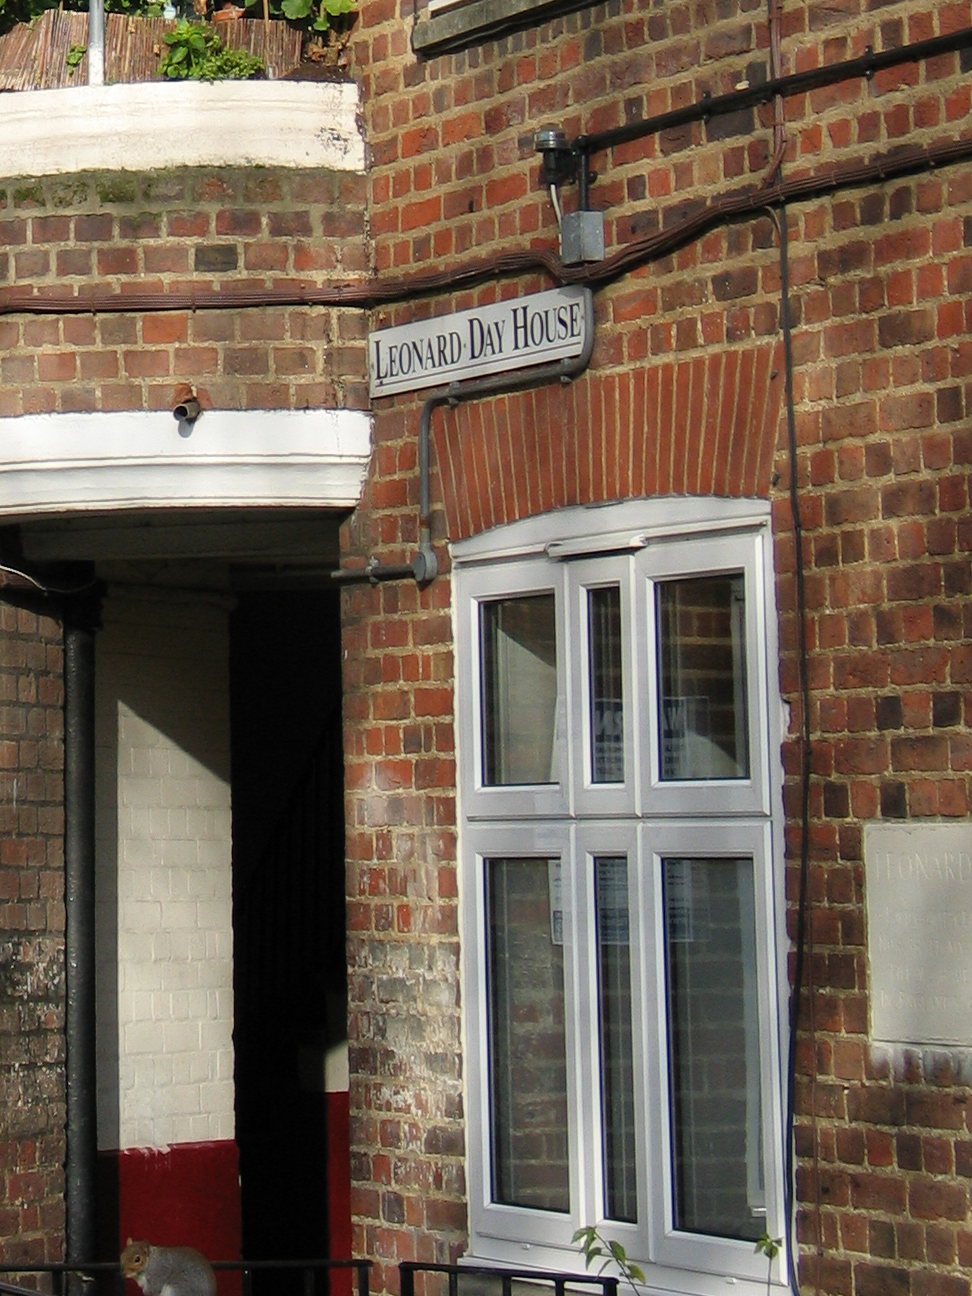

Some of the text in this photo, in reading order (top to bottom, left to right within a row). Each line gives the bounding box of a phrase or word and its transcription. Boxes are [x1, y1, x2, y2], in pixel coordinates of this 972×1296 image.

[374, 302, 581, 380] LEONARD DAY HOUSE
